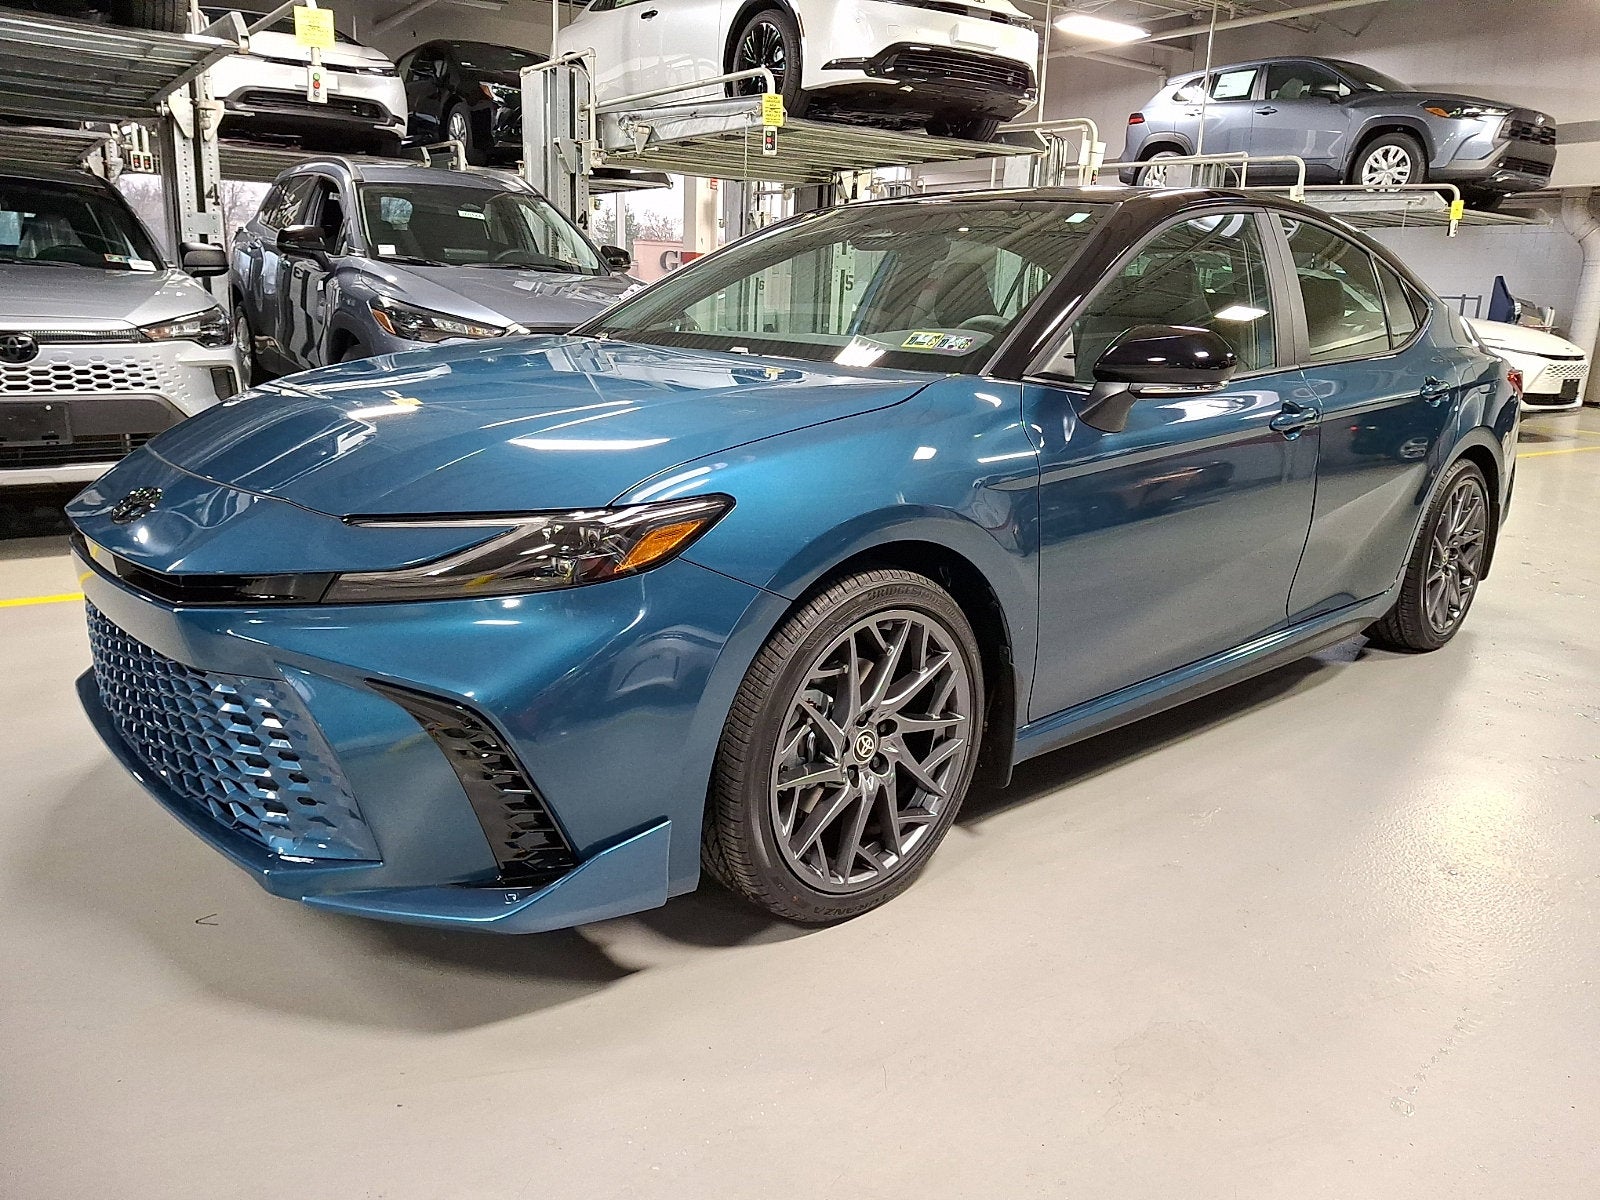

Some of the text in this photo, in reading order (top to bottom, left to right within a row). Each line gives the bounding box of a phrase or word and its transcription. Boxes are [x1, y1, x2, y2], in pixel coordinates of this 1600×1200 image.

[205, 183, 220, 206] 4
[577, 210, 589, 230] 4
[659, 250, 679, 272] G
[845, 274, 854, 291] 5
